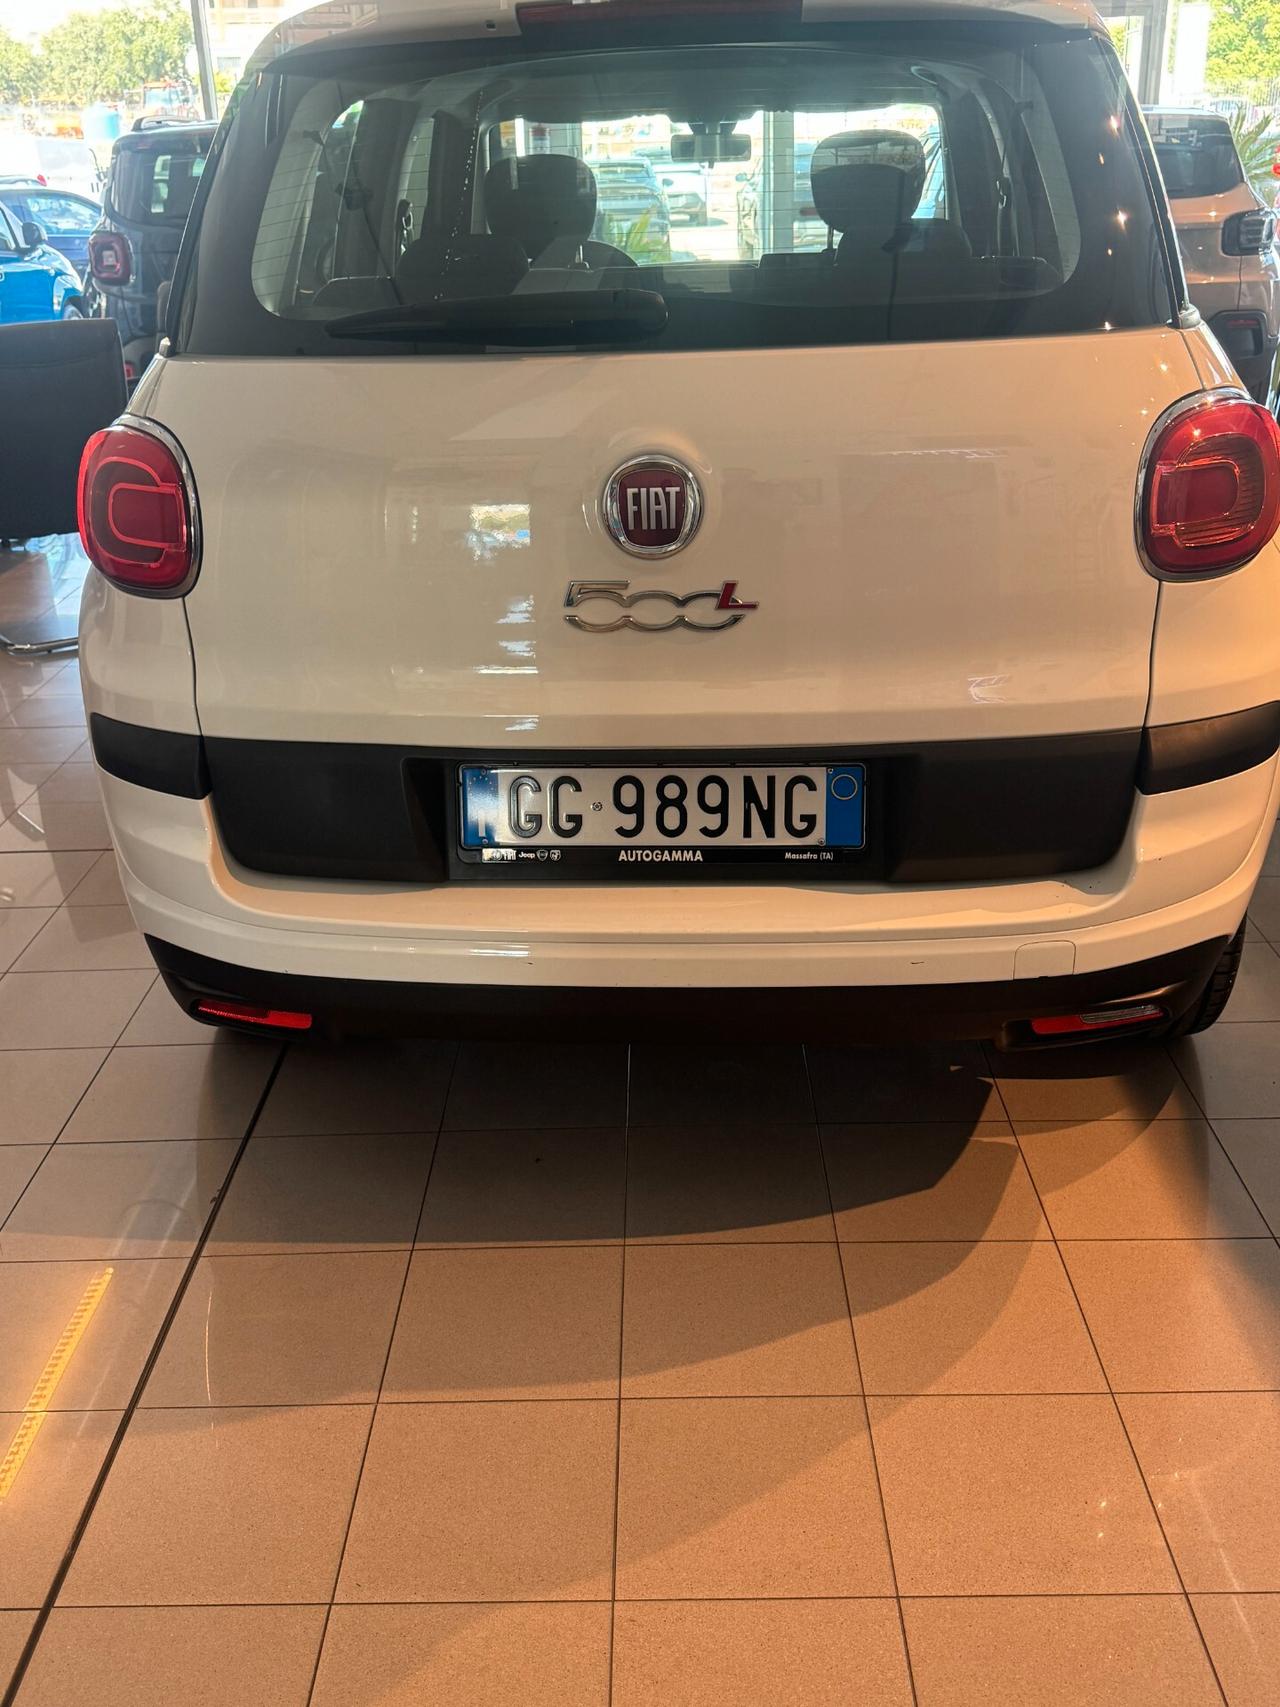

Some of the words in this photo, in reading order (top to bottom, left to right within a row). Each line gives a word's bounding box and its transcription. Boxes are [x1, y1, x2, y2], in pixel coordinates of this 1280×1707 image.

[626, 486, 681, 530] FIAT
[509, 775, 583, 838] GG
[612, 774, 818, 839] 989NG
[618, 850, 704, 862] AUTOGAMMA
[784, 851, 818, 860] Massafra
[819, 851, 834, 861] (TA)
